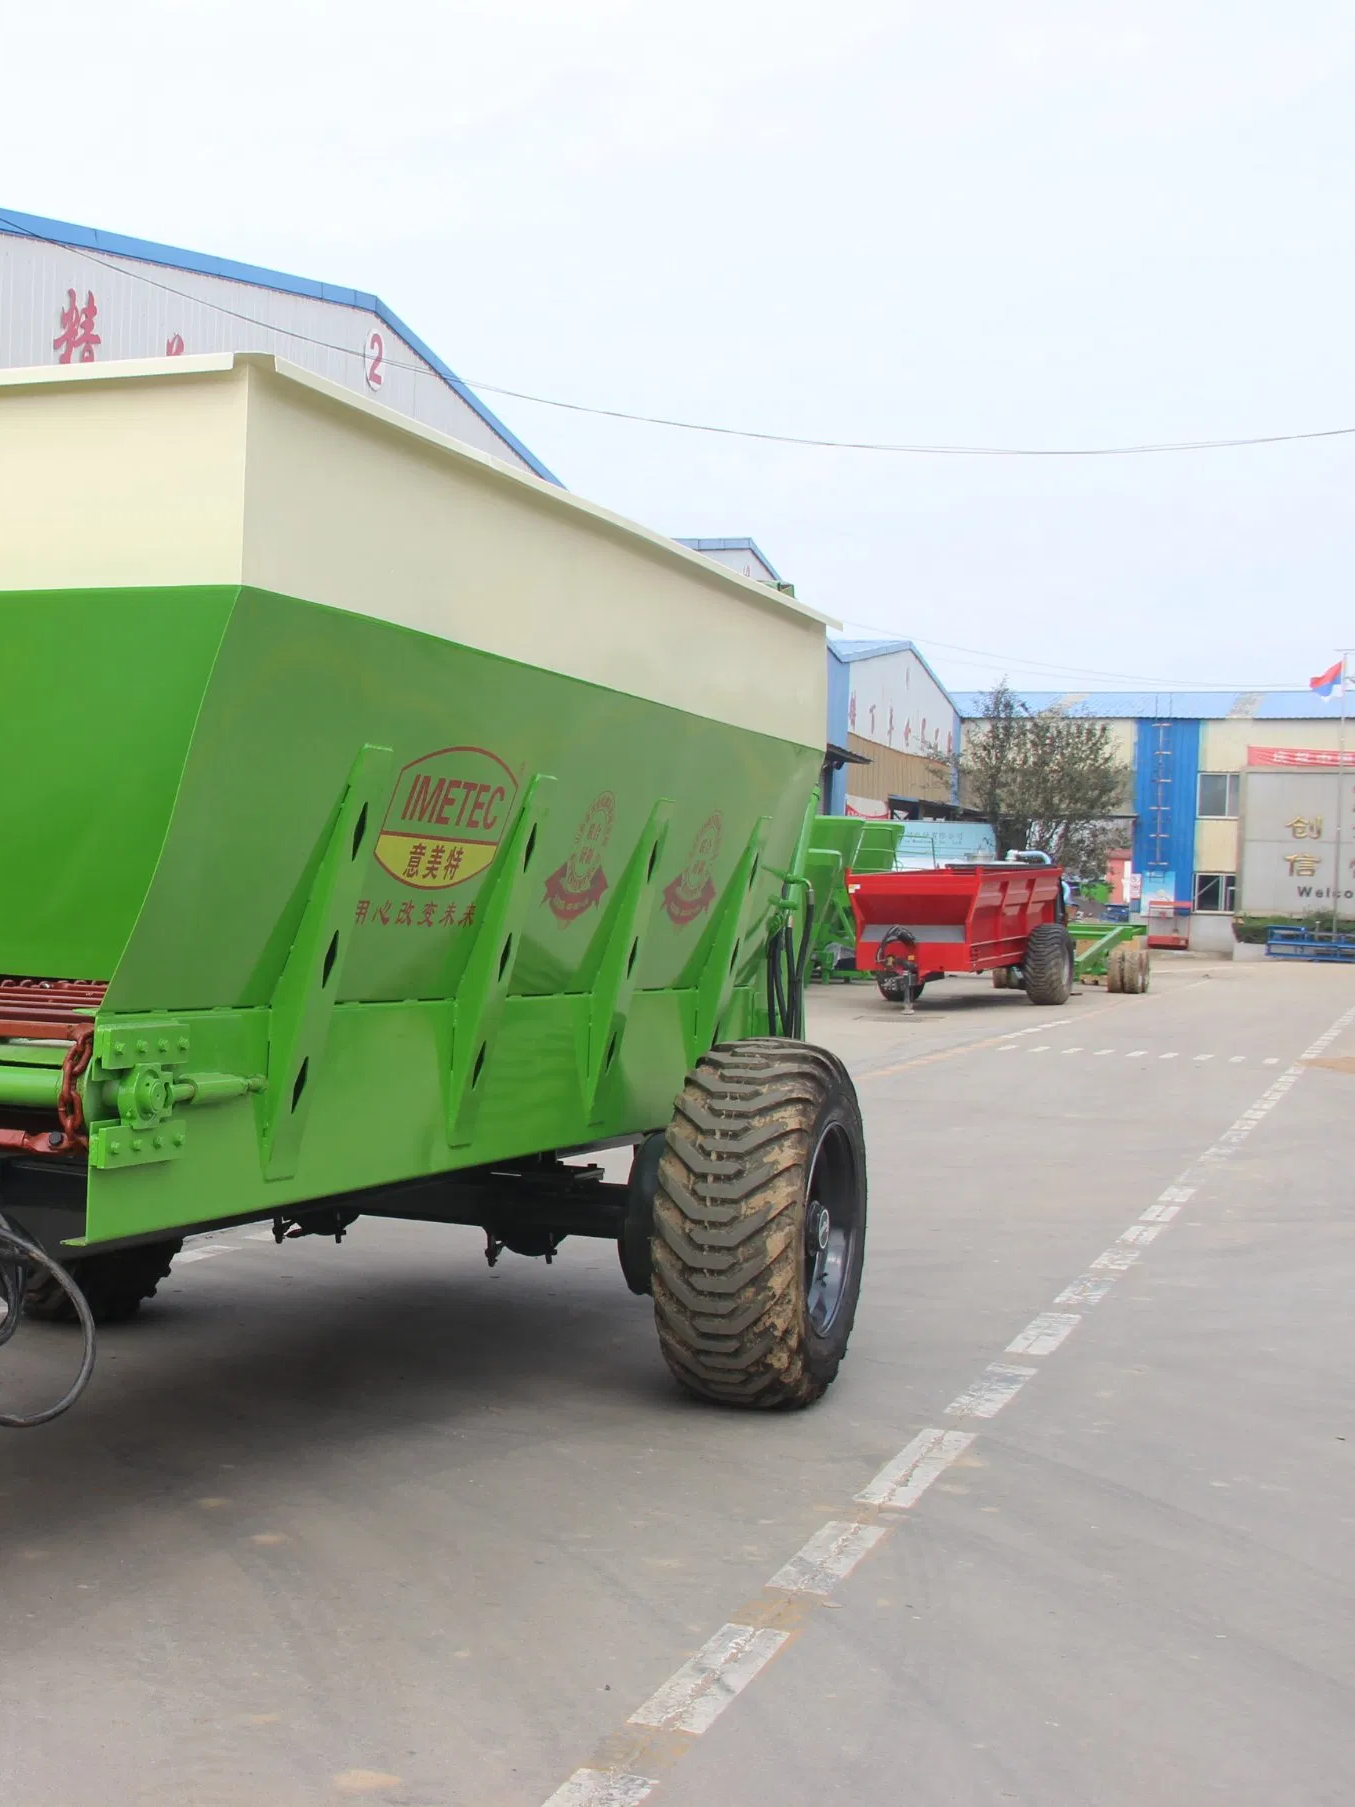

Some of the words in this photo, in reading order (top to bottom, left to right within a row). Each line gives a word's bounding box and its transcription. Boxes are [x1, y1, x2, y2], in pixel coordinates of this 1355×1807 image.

[367, 333, 384, 386] 2
[401, 774, 506, 830] IMETEC
[1285, 816, 1325, 840] 创
[402, 842, 465, 881] 意美特
[1284, 853, 1321, 877] 信
[355, 900, 476, 929] 用心改变未来
